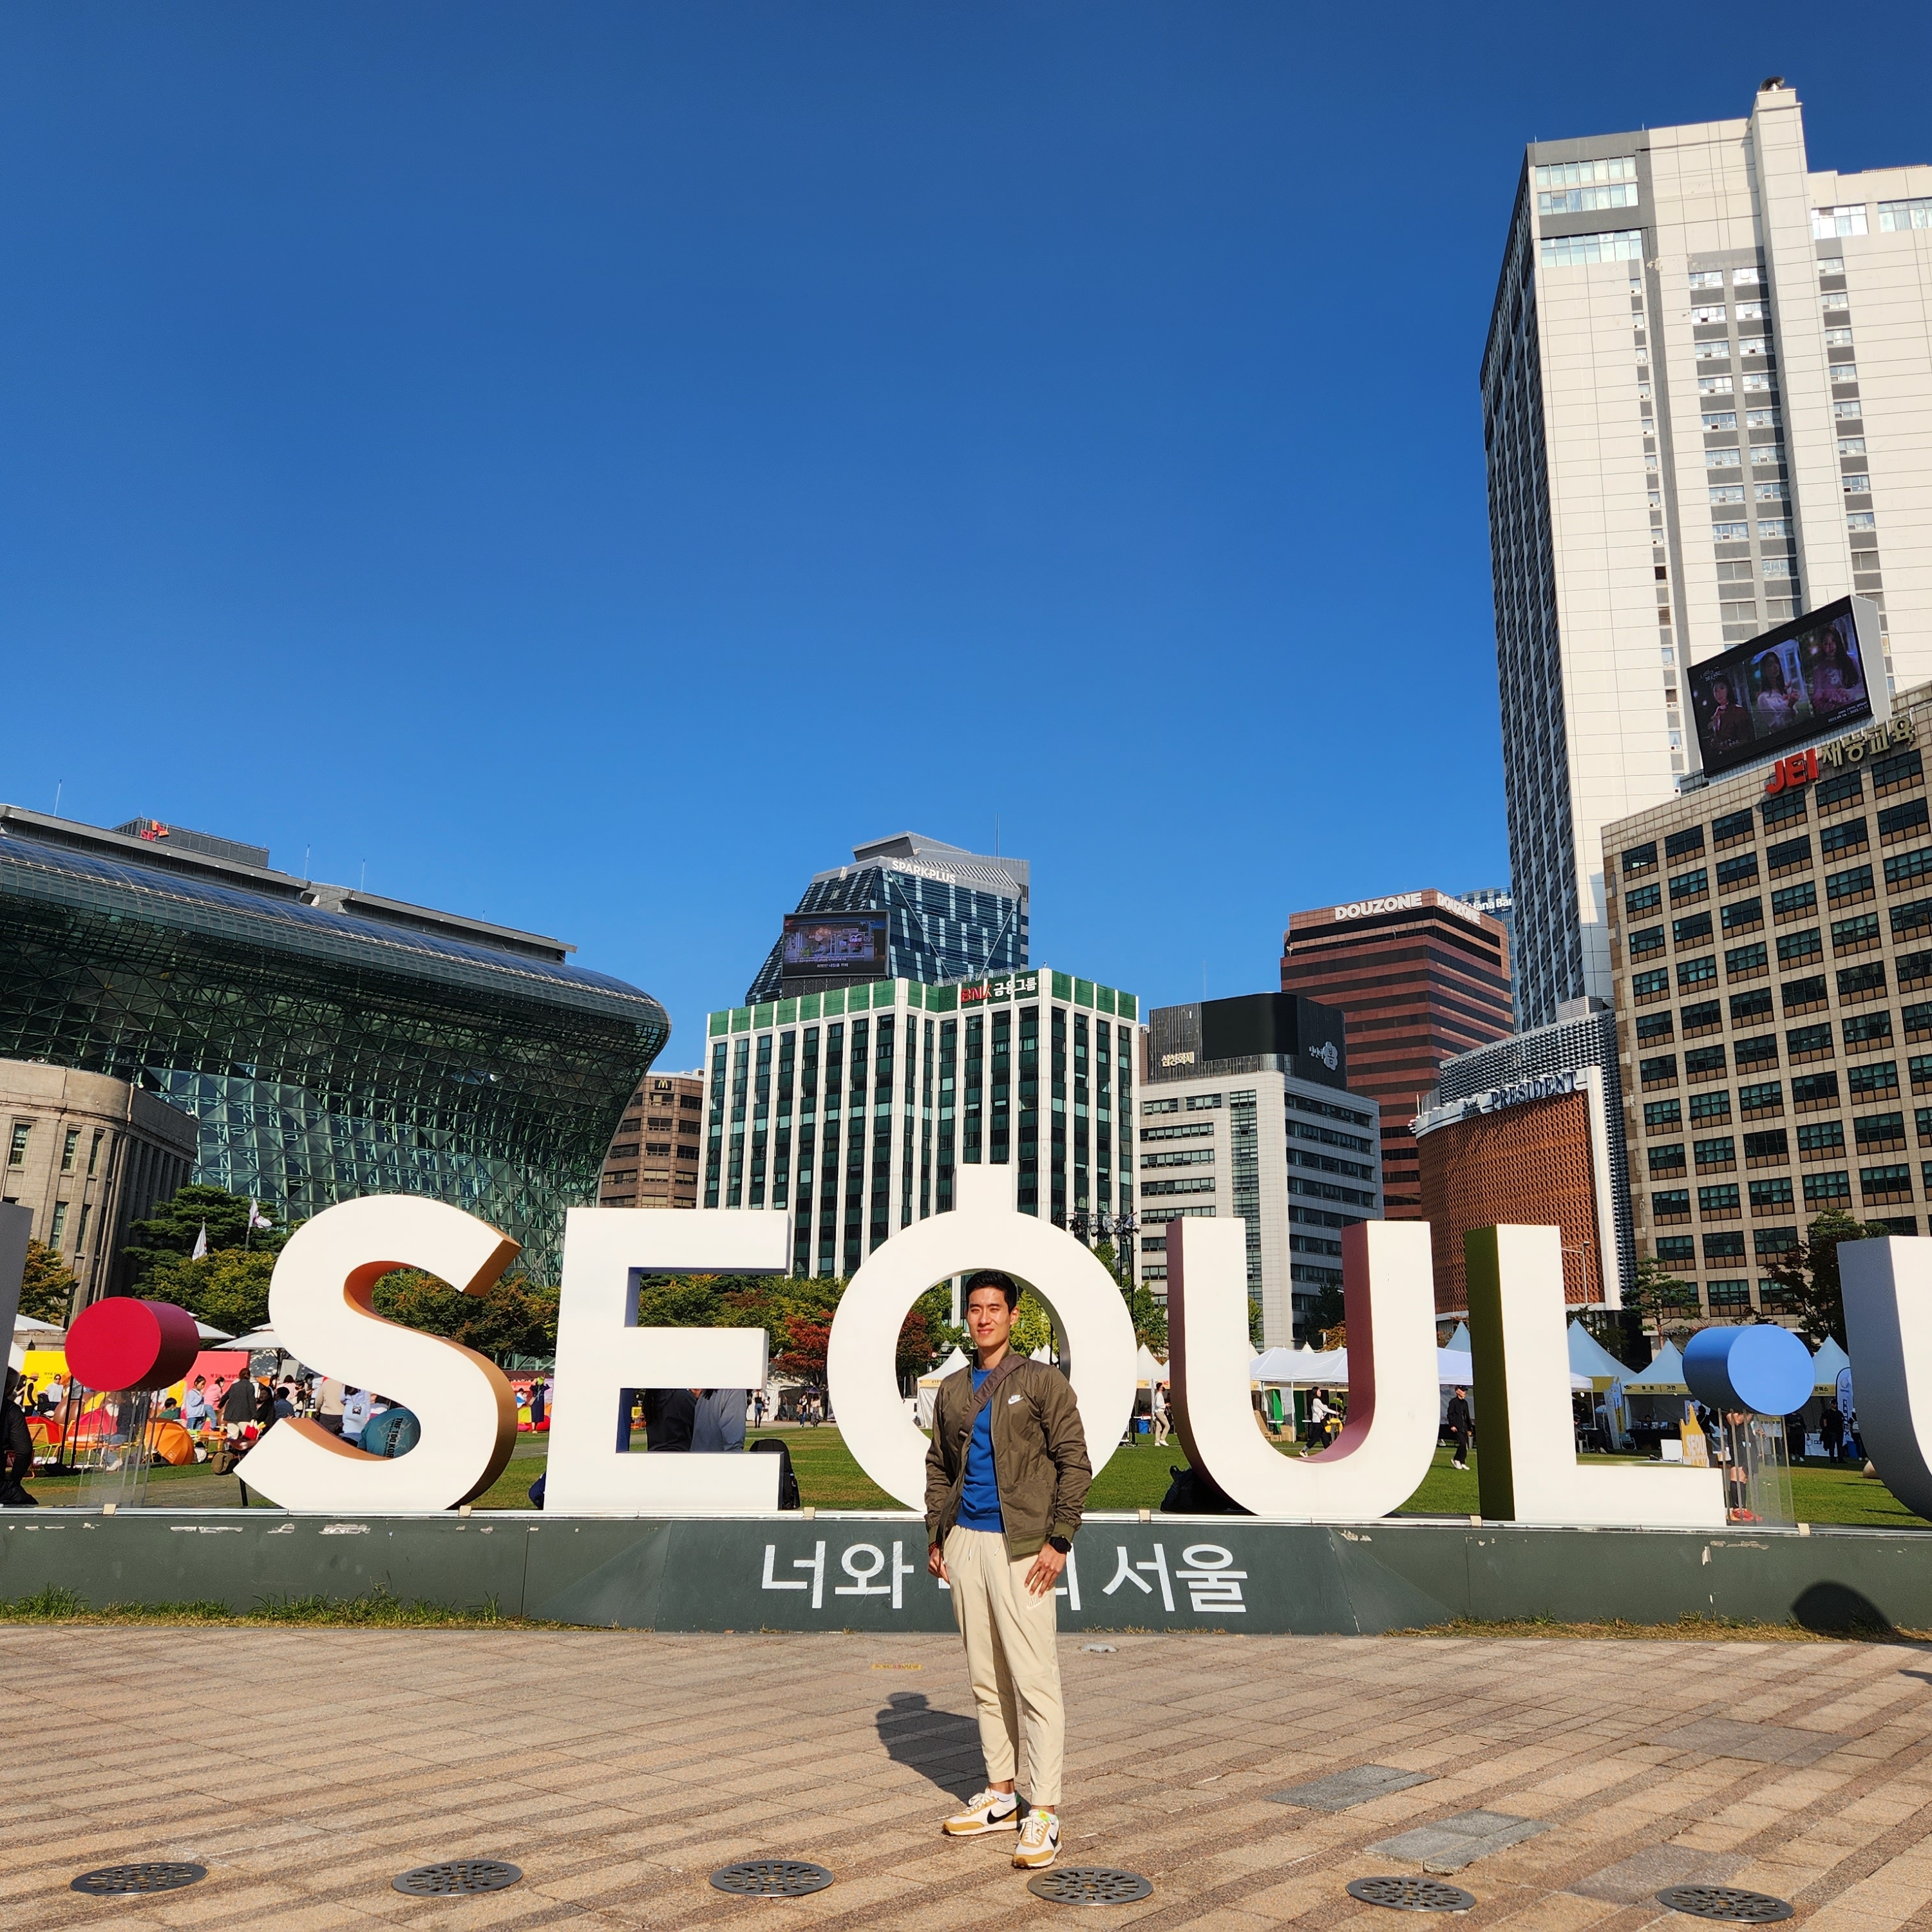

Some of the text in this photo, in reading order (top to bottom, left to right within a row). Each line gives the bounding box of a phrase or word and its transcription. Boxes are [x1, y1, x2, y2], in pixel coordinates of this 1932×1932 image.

[1766, 715, 1915, 794] JEI 재능교육
[140, 828, 157, 842] SK
[892, 860, 956, 884] SPARKPLUS
[1334, 892, 1423, 921] DOUZONE
[1437, 891, 1481, 925] DOUZONE
[961, 977, 1037, 1003] BNK 금융그룹
[1161, 1051, 1195, 1067] 삼성화재
[1491, 1071, 1578, 1111] PRESIDENT
[234, 1162, 1728, 1527] SEOUL
[389, 1430, 399, 1443] 100
[393, 1417, 404, 1429] TNF
[761, 1540, 914, 1609] 너와
[1103, 1542, 1248, 1613] 서울
